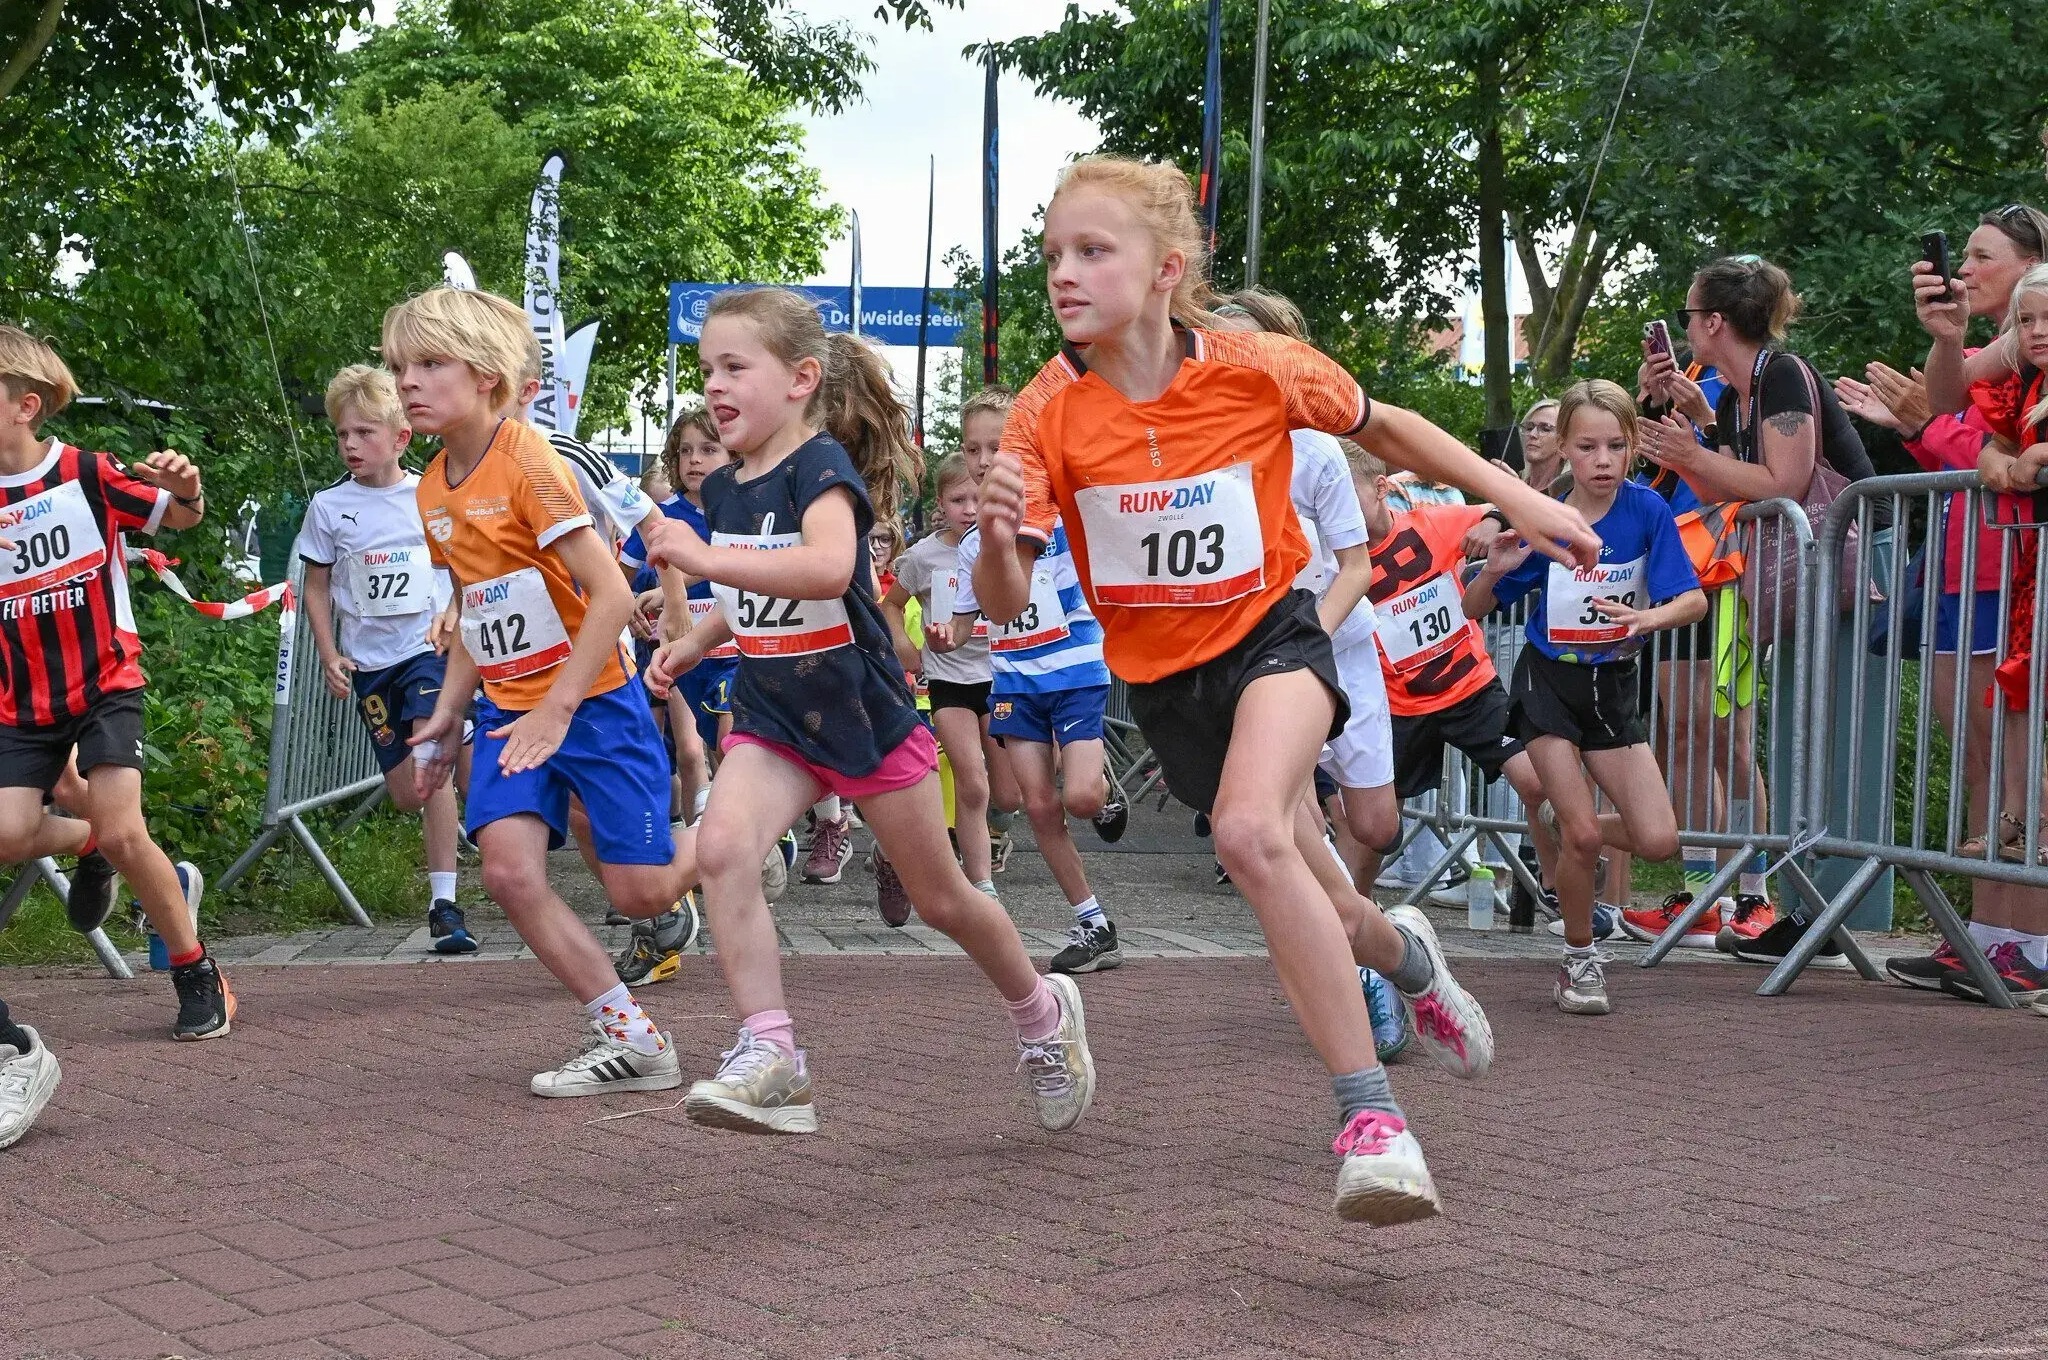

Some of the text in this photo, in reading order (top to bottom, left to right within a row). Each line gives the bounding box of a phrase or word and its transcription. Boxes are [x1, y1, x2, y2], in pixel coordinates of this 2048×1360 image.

[860, 309, 964, 327] Weideseen
[1119, 481, 1216, 513] RUN2DAY
[1158, 514, 1184, 522] ZWOLLE
[13, 524, 70, 574] 300
[1141, 523, 1224, 577] 103
[3, 587, 85, 621] FLY BETTER
[368, 572, 410, 600] 372
[738, 589, 803, 628] 522
[1410, 606, 1451, 647] 130
[481, 613, 531, 658] 412
[276, 649, 289, 692] ROVA
[644, 811, 653, 844] KIPSTA
